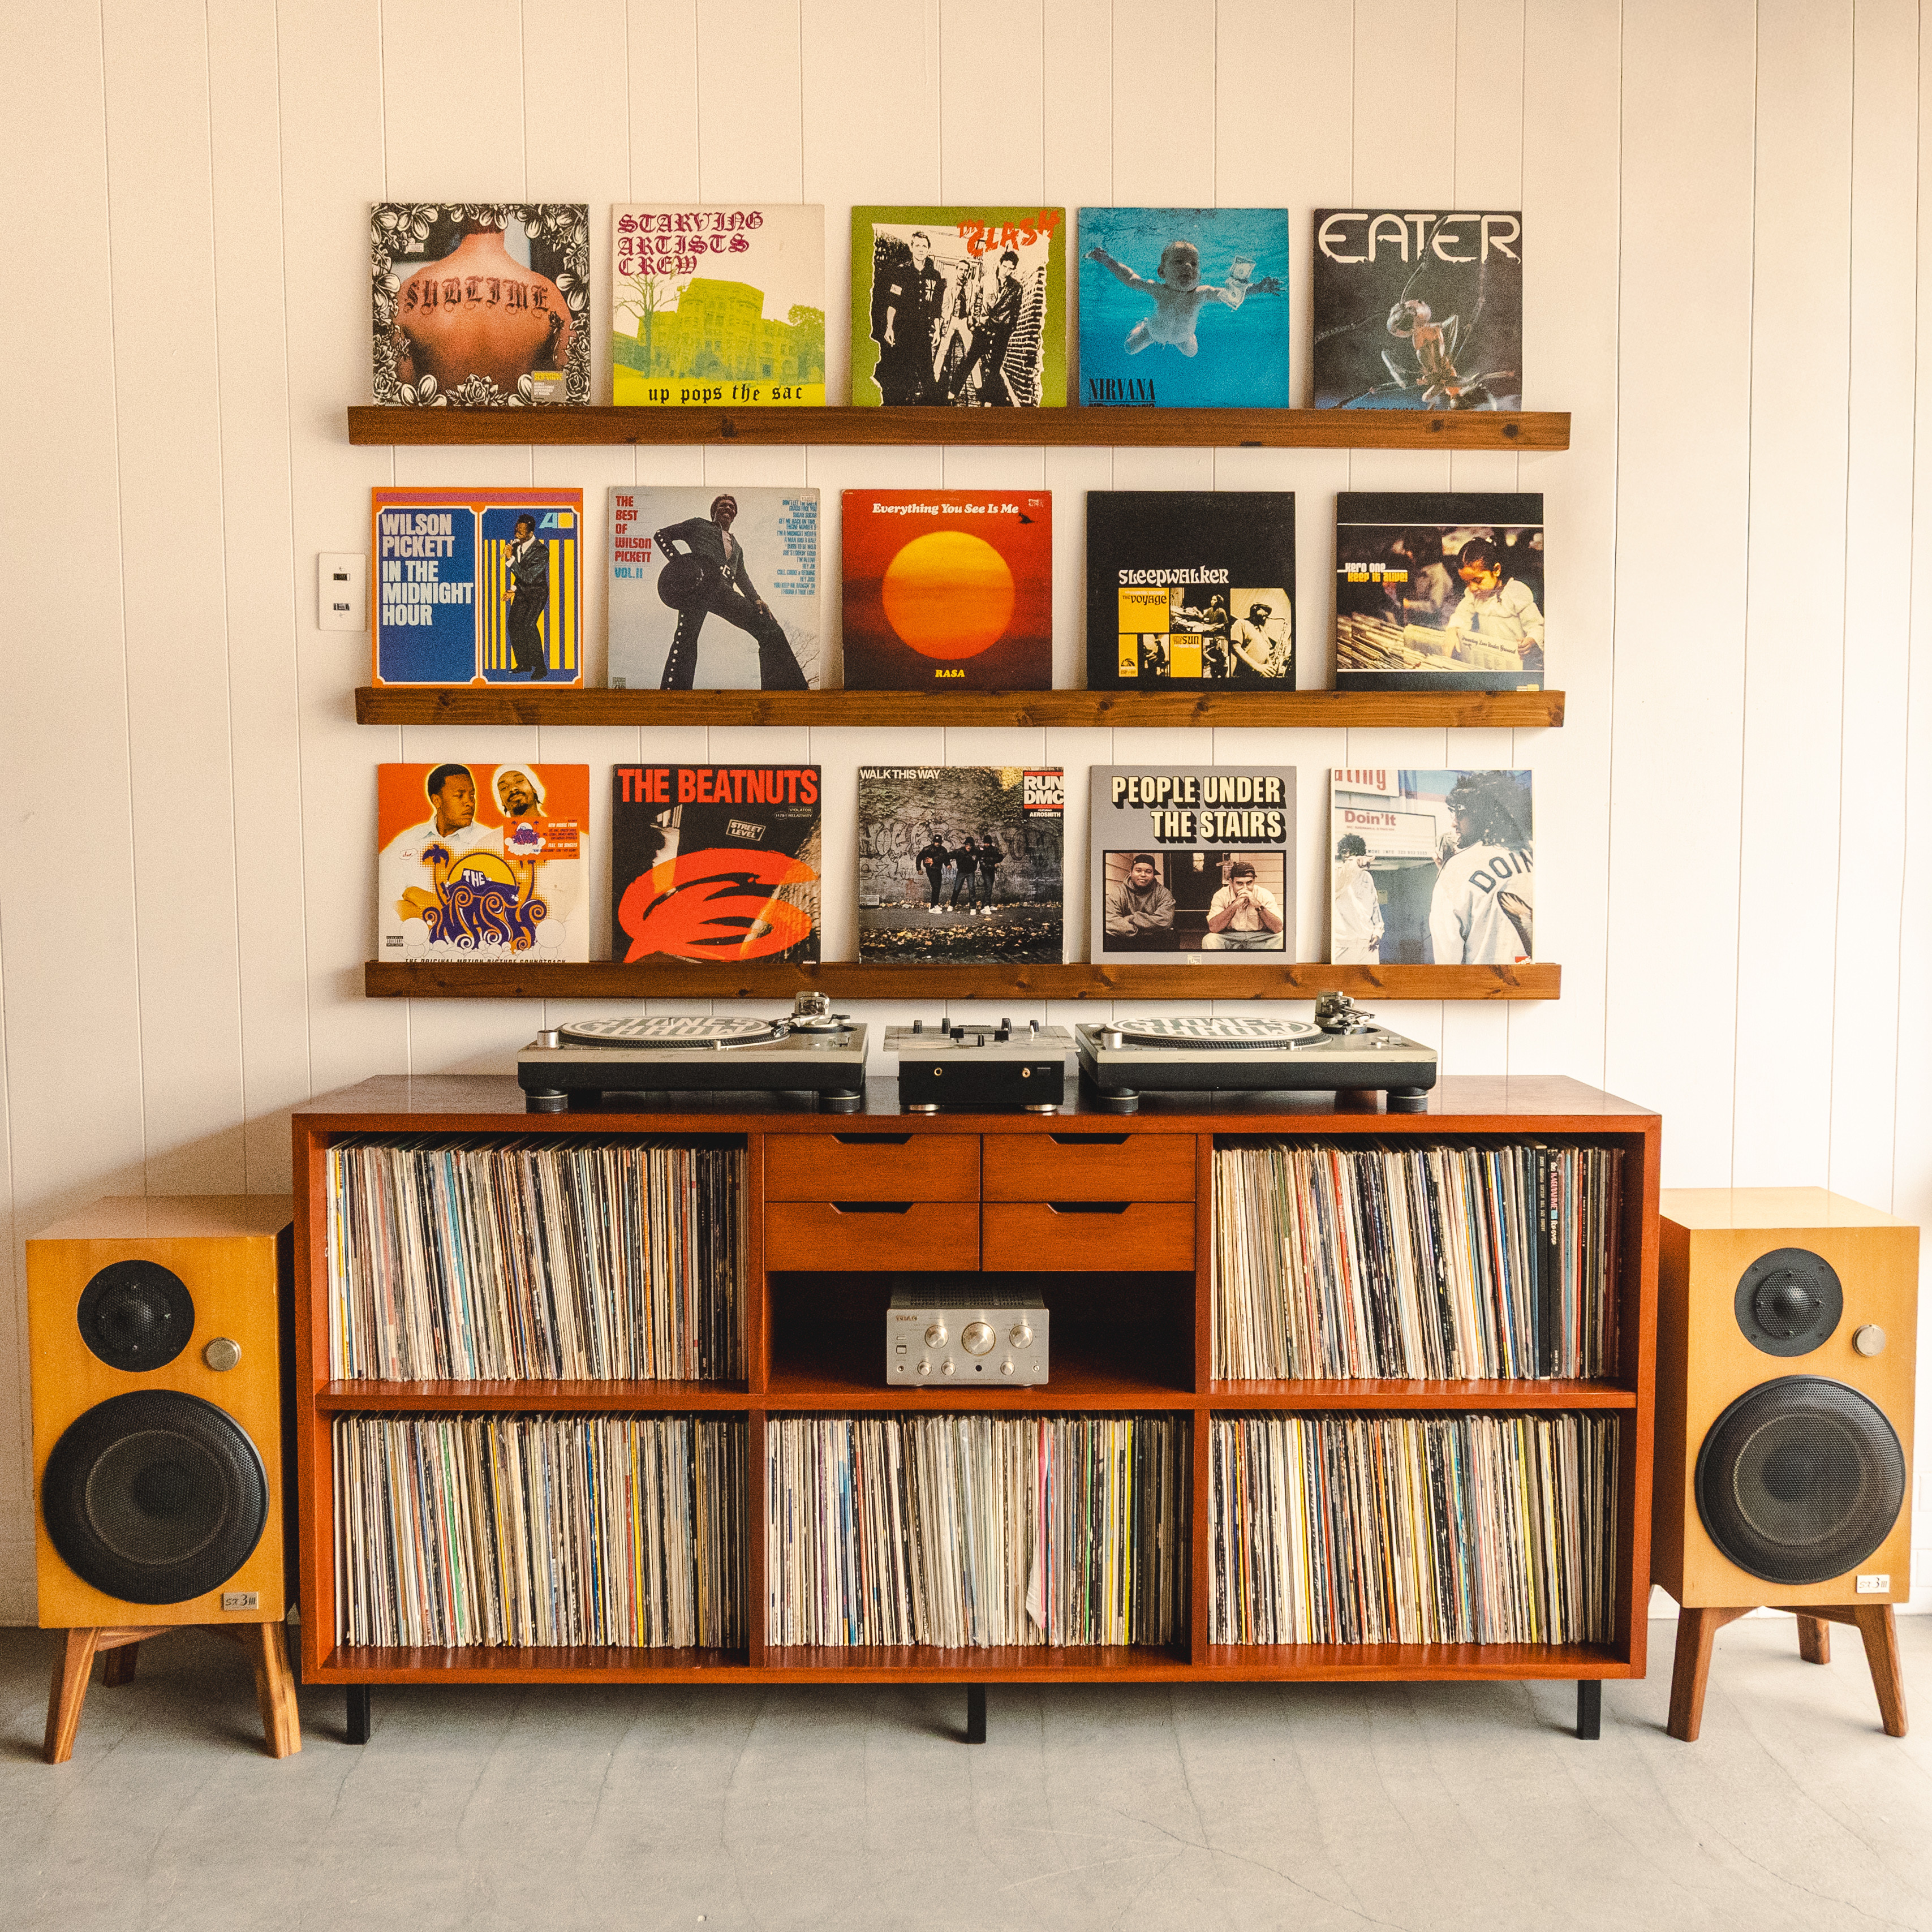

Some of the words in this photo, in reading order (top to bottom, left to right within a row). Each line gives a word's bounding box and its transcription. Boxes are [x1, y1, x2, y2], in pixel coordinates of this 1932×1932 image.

[617, 211, 763, 233] STARVING
[967, 210, 1060, 257] CLASH
[1318, 213, 1521, 264] EATER
[617, 233, 750, 256] ARTISTS
[618, 255, 698, 276] CREW
[403, 275, 549, 318] SUBLIME
[648, 388, 669, 404] up
[681, 386, 722, 405] pops
[732, 384, 760, 402] the
[772, 385, 802, 399] sac
[1088, 378, 1155, 399] NIRVANA
[616, 496, 634, 507] THE
[872, 503, 939, 515] Everything
[941, 504, 962, 513] You
[964, 504, 985, 513] See
[987, 504, 999, 514] Is
[1000, 504, 1019, 514] Me
[381, 513, 451, 535] WILSON
[616, 510, 638, 520] BEST
[615, 523, 627, 534] OF
[382, 536, 455, 557] PICKETT
[615, 537, 652, 549] WILSON
[614, 550, 652, 562] PICKETT
[382, 561, 401, 582] IN
[406, 561, 438, 582] THE
[614, 566, 635, 578] VOL.
[1348, 572, 1369, 582] keep
[1372, 572, 1380, 582] it
[382, 582, 474, 604] MIDNIGHT
[382, 605, 433, 626] HOUR
[935, 669, 965, 678] RASA
[859, 769, 891, 779] WALK
[892, 769, 916, 779] THIS
[917, 769, 940, 779] WAY
[1024, 776, 1064, 790] RUN
[618, 768, 670, 803] THE
[678, 769, 817, 804] BEATNUTS
[1112, 776, 1199, 808] PEOPLE
[1203, 776, 1286, 808] UNDER
[1024, 790, 1064, 804] DMC
[731, 822, 763, 832] STREET
[732, 828, 756, 838] LEVEL
[1151, 811, 1197, 844] THE
[1200, 811, 1286, 844] STAIRS
[463, 869, 486, 887] THE
